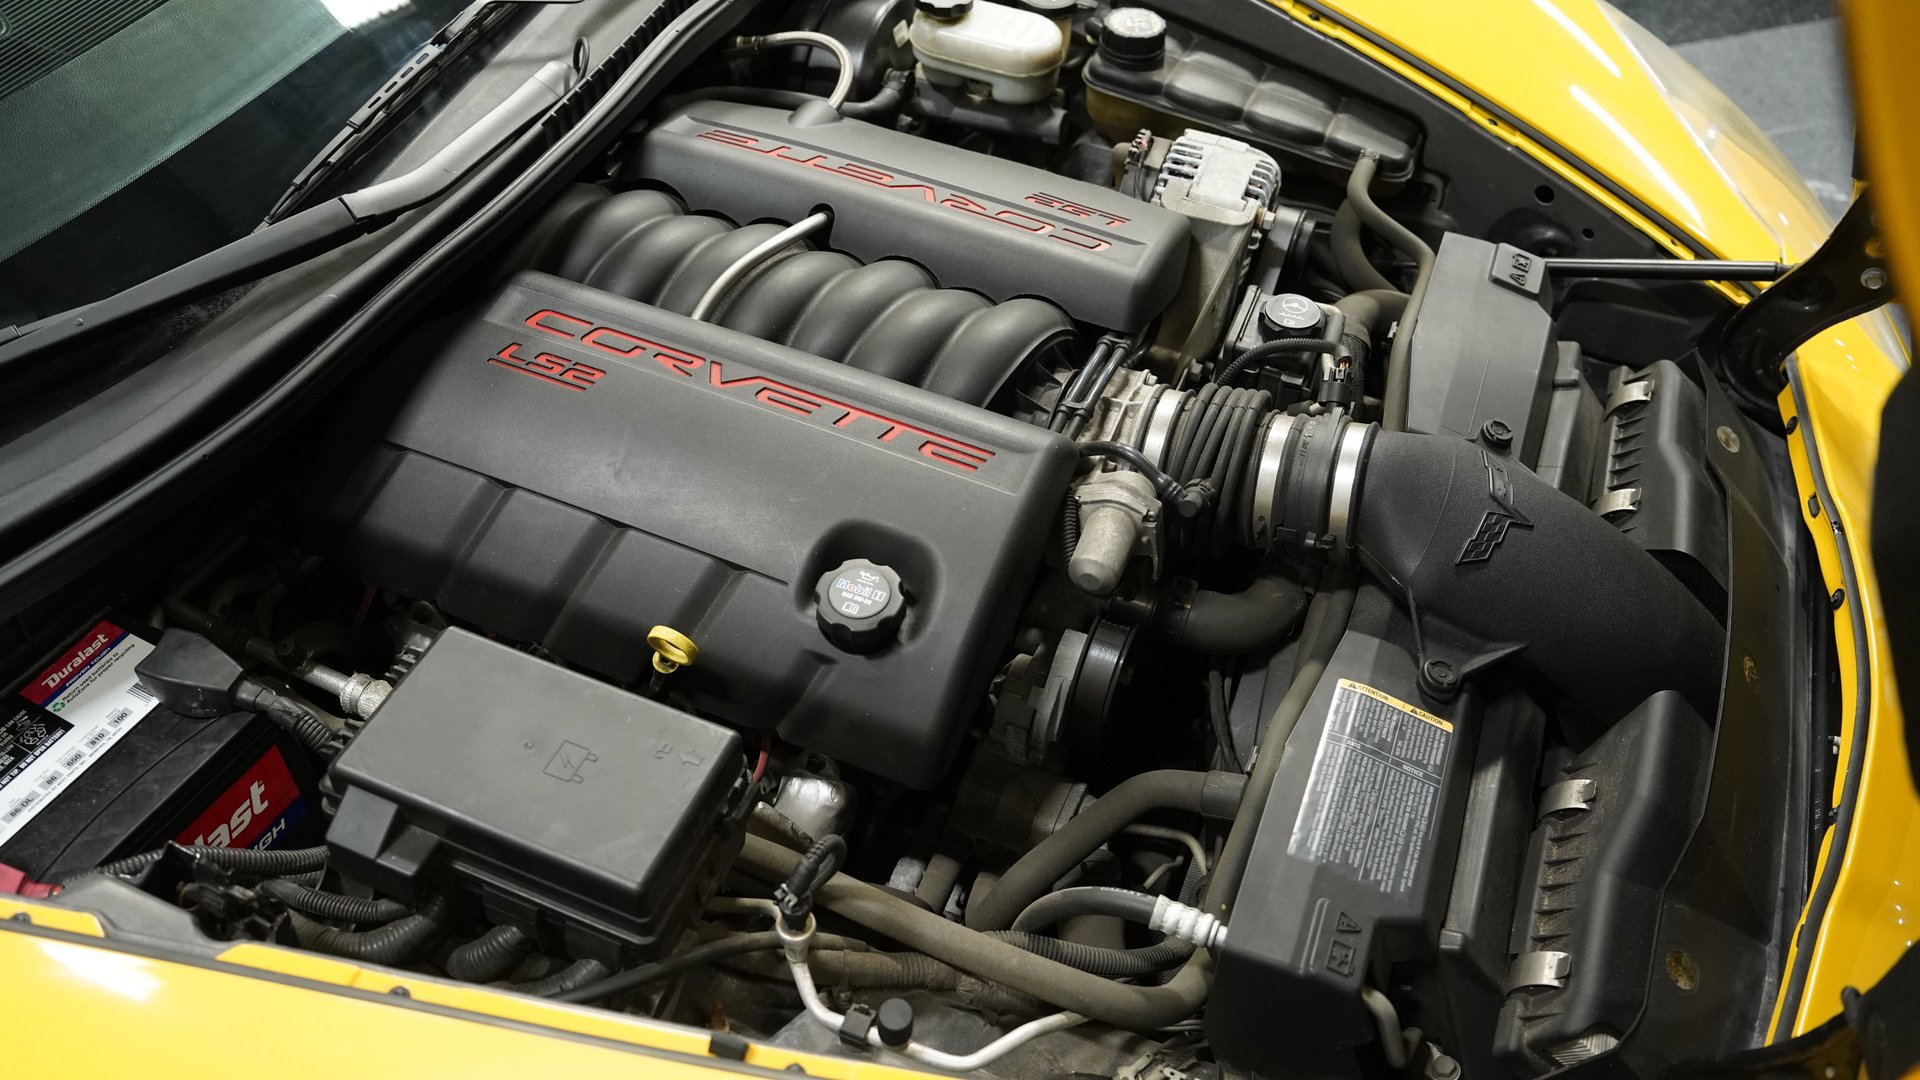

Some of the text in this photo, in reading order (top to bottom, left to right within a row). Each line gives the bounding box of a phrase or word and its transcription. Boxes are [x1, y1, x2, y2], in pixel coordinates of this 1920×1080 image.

[697, 130, 1112, 252] CORVETTE
[1024, 191, 1131, 228] LS2
[495, 342, 607, 389] LS2
[524, 308, 997, 472] CORVETTE
[836, 578, 872, 598] Mobil
[41, 633, 109, 688] Duralast
[65, 647, 111, 687] PROVEN TOUGH
[67, 682, 91, 704] AutoZone
[114, 643, 136, 663] recycling
[62, 685, 80, 701] Return
[80, 675, 92, 687] used
[91, 657, 113, 676] batteries
[1357, 684, 1389, 701] ATTENTION
[113, 712, 128, 725] 100
[1418, 711, 1443, 726] CAUTION
[90, 732, 105, 746] 810
[66, 753, 82, 767] 650
[1402, 763, 1424, 778] NOTICE
[46, 775, 58, 785] 86
[9, 797, 35, 818] 86-DL
[253, 817, 286, 851] GH
